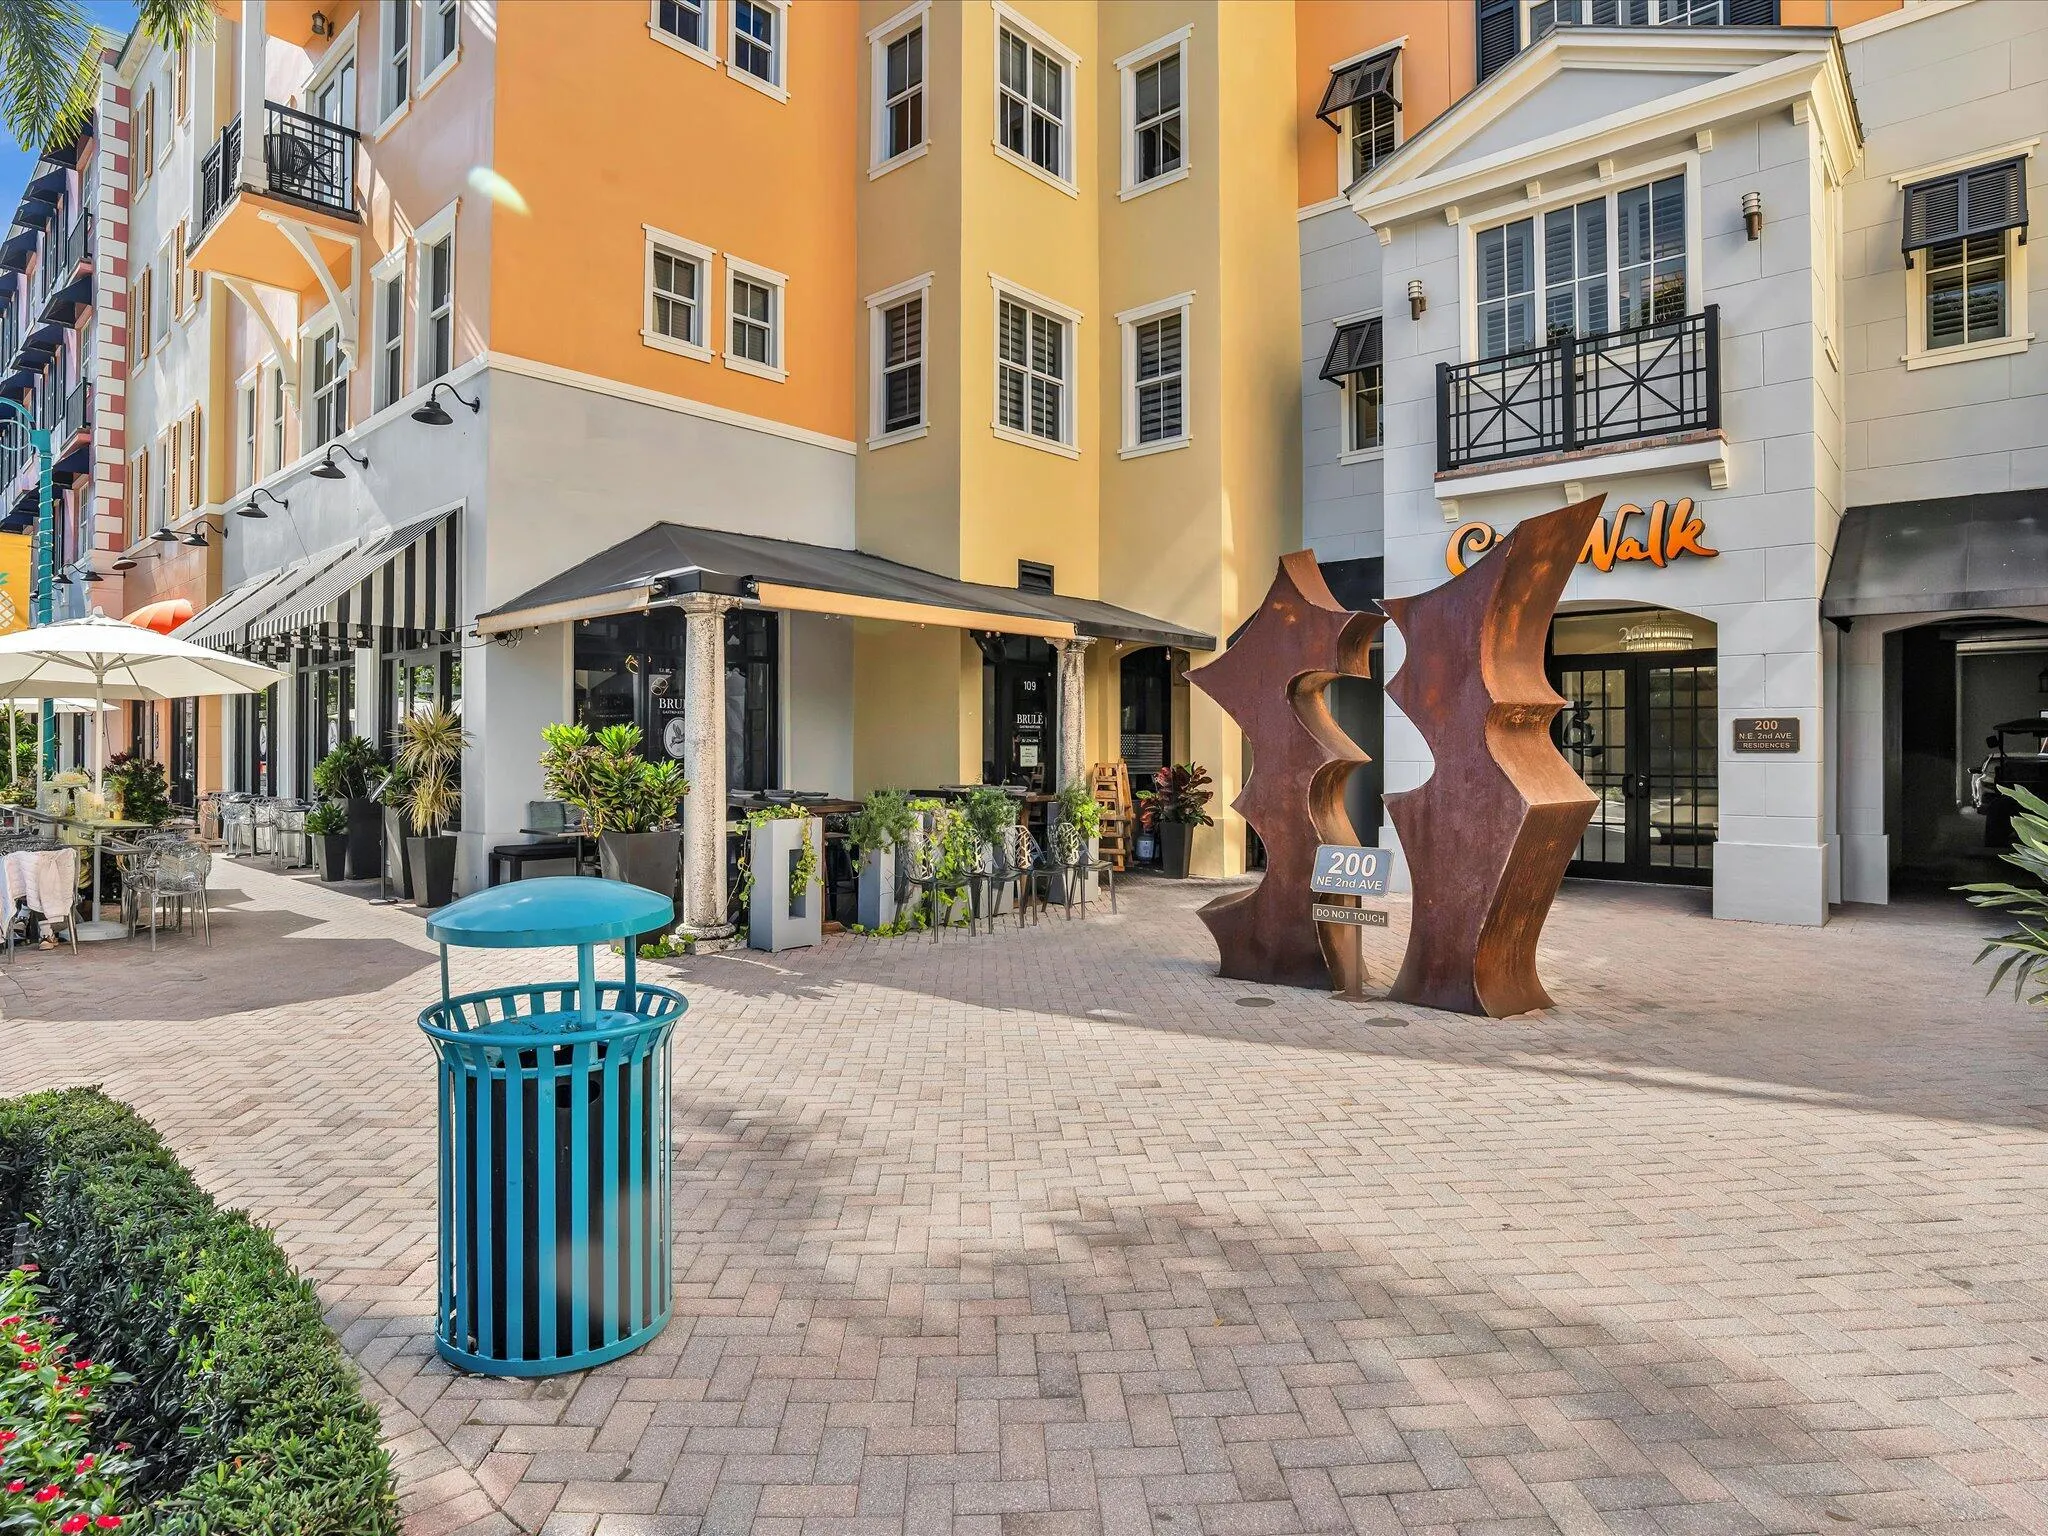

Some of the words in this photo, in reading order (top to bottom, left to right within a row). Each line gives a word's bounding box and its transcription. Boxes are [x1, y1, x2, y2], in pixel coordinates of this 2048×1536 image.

[1023, 680, 1037, 691] 109
[658, 697, 685, 709] BRU
[1016, 712, 1043, 725] BRULÉ
[1754, 720, 1778, 730] 200
[1739, 732, 1755, 740] N.E.
[1757, 732, 1773, 740] 2nd
[1775, 732, 1794, 740] AVE.
[1328, 851, 1377, 877] 200
[1316, 875, 1332, 887] NE
[1335, 877, 1356, 889] 2nd
[1358, 879, 1383, 891] AVE
[1316, 908, 1330, 918] DO
[1331, 910, 1350, 919] NOT
[1353, 912, 1385, 923] TOUCH
